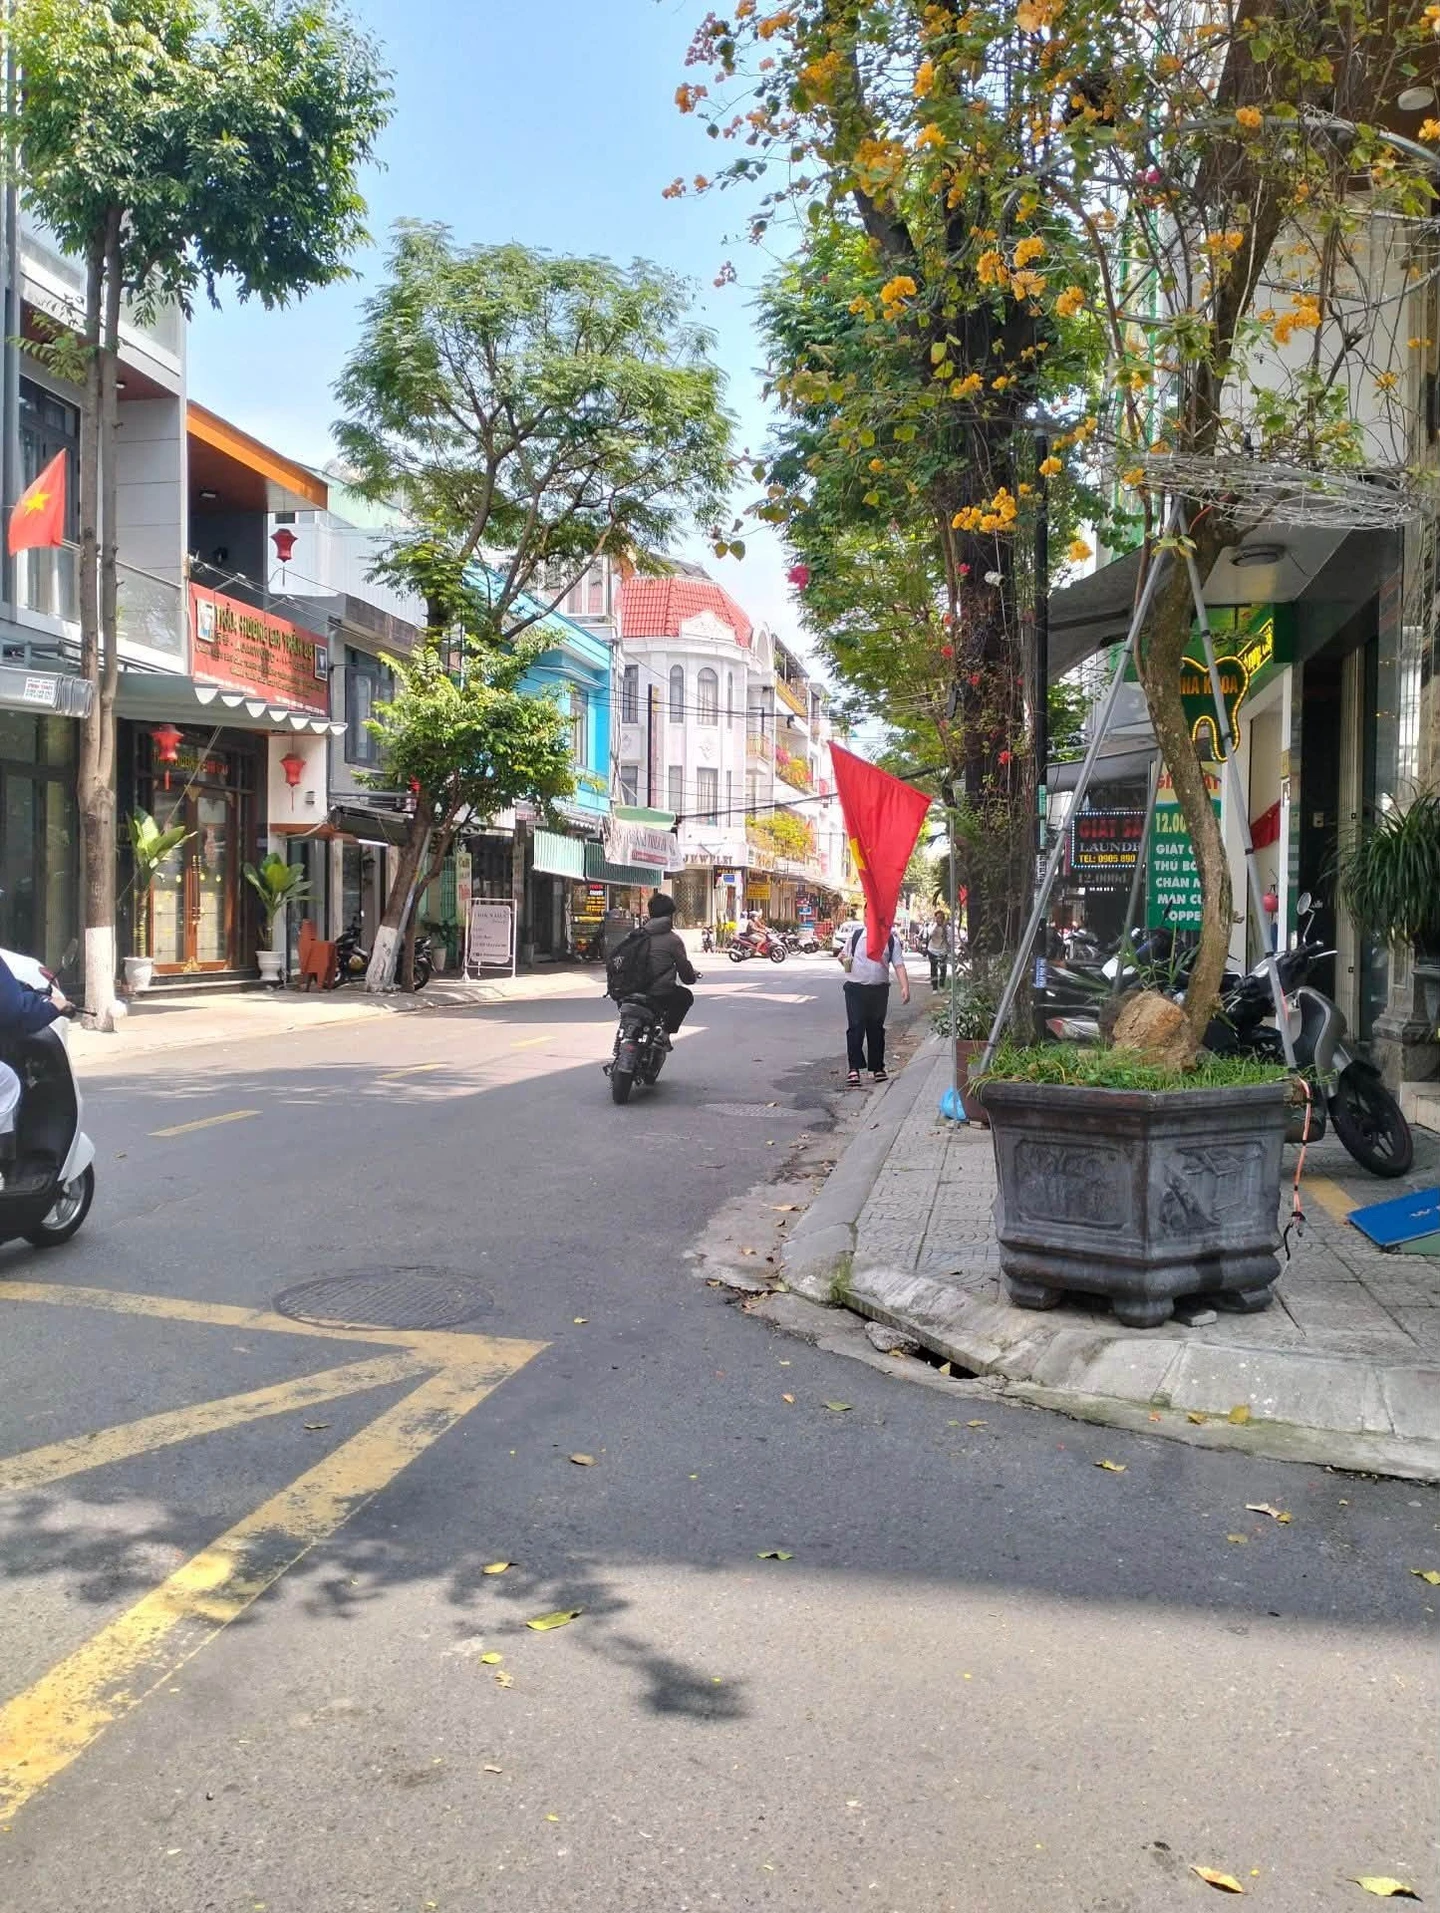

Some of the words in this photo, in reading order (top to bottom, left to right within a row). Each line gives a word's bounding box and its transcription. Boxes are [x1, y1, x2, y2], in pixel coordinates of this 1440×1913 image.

[1180, 676, 1199, 694] HA
[1203, 675, 1238, 694] KOA
[1080, 841, 1141, 852] LAUNDR
